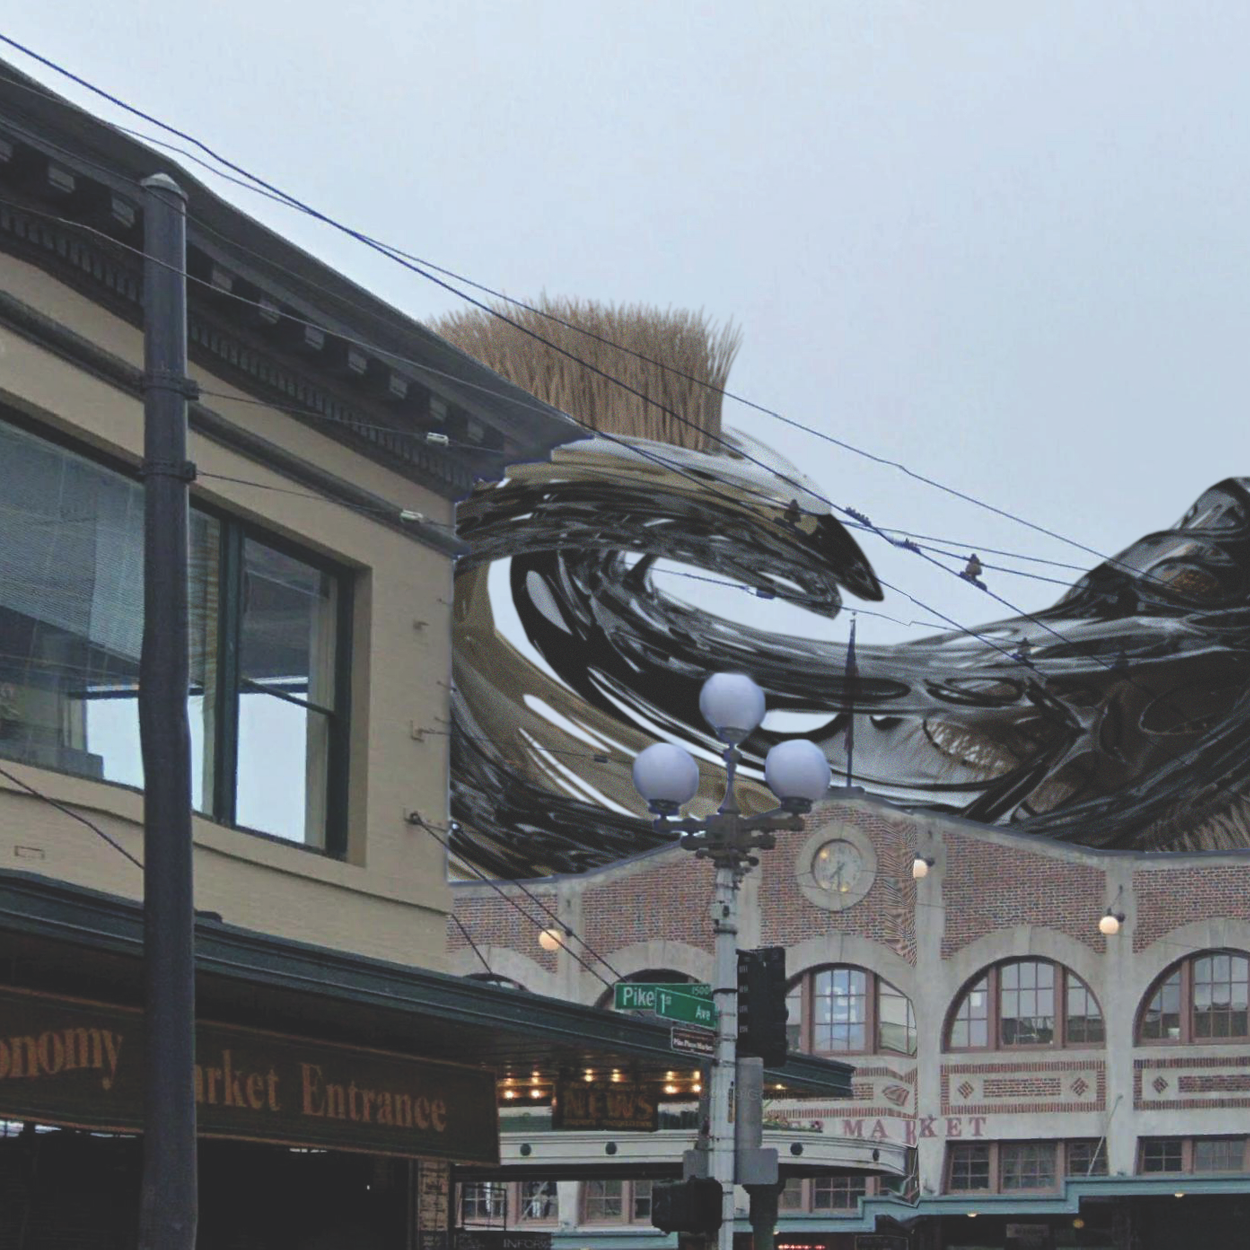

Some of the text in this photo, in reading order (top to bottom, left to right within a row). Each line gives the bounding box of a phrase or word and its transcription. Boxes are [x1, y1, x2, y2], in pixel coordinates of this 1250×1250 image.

[623, 986, 655, 1006] Pike
[692, 986, 711, 996] 1500
[695, 1005, 711, 1021] Ave
[300, 1062, 447, 1132] Entrance
